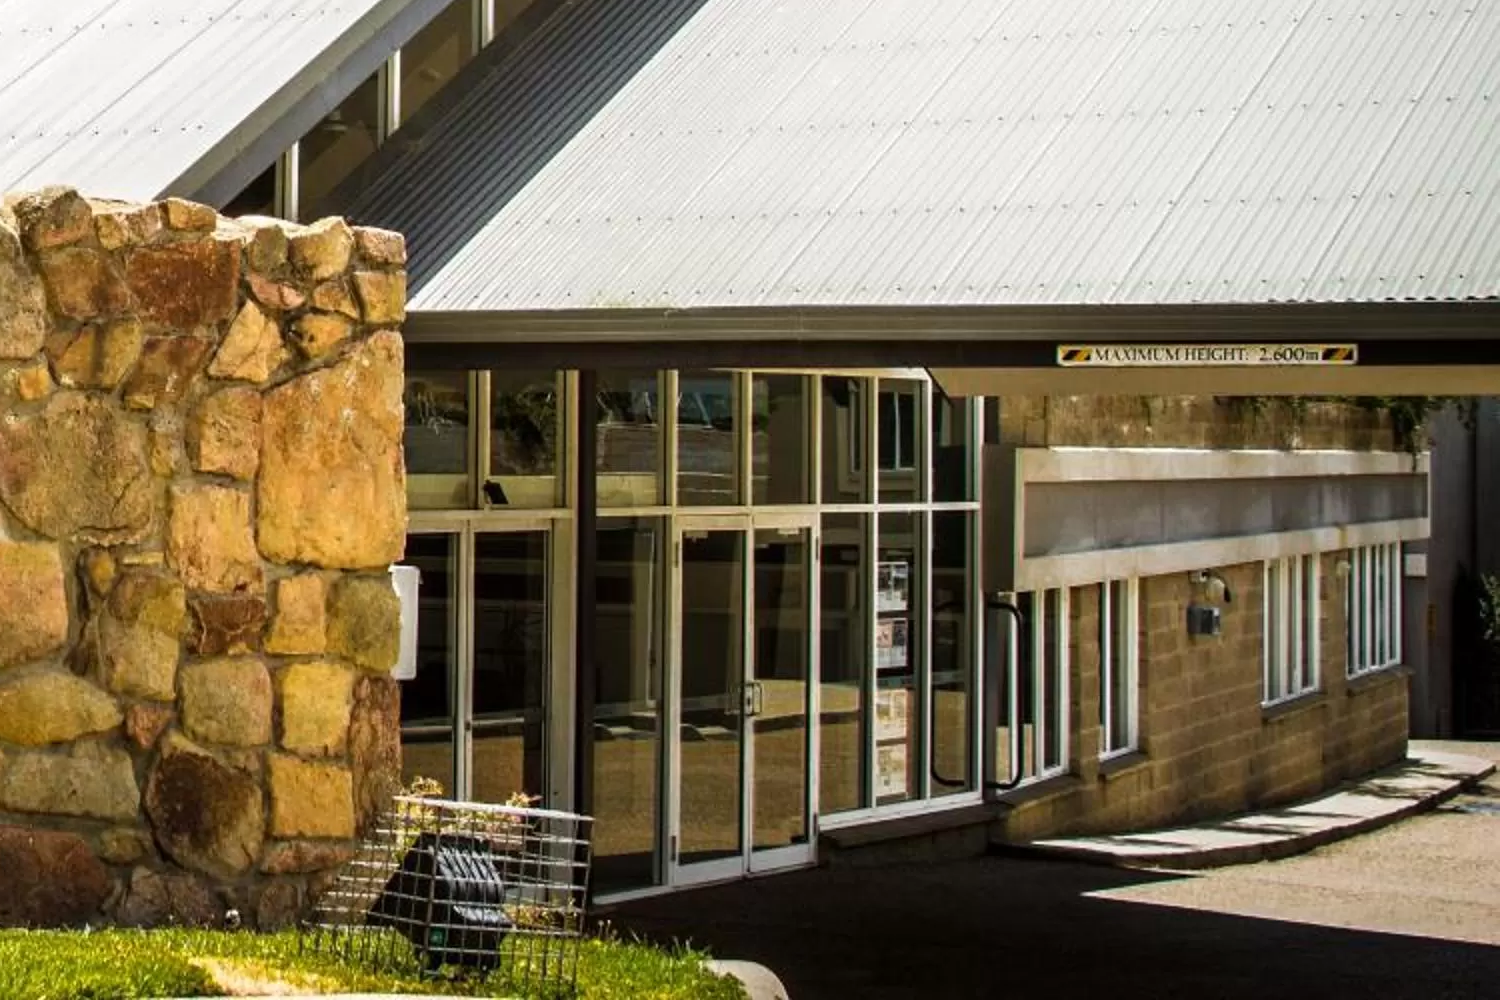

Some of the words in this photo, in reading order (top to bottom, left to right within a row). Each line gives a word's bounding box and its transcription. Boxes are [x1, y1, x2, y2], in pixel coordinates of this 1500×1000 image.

[1095, 346, 1181, 362] MAXIMUM
[1184, 346, 1250, 362] HEIGHT:
[1258, 346, 1320, 362] 2.600m
